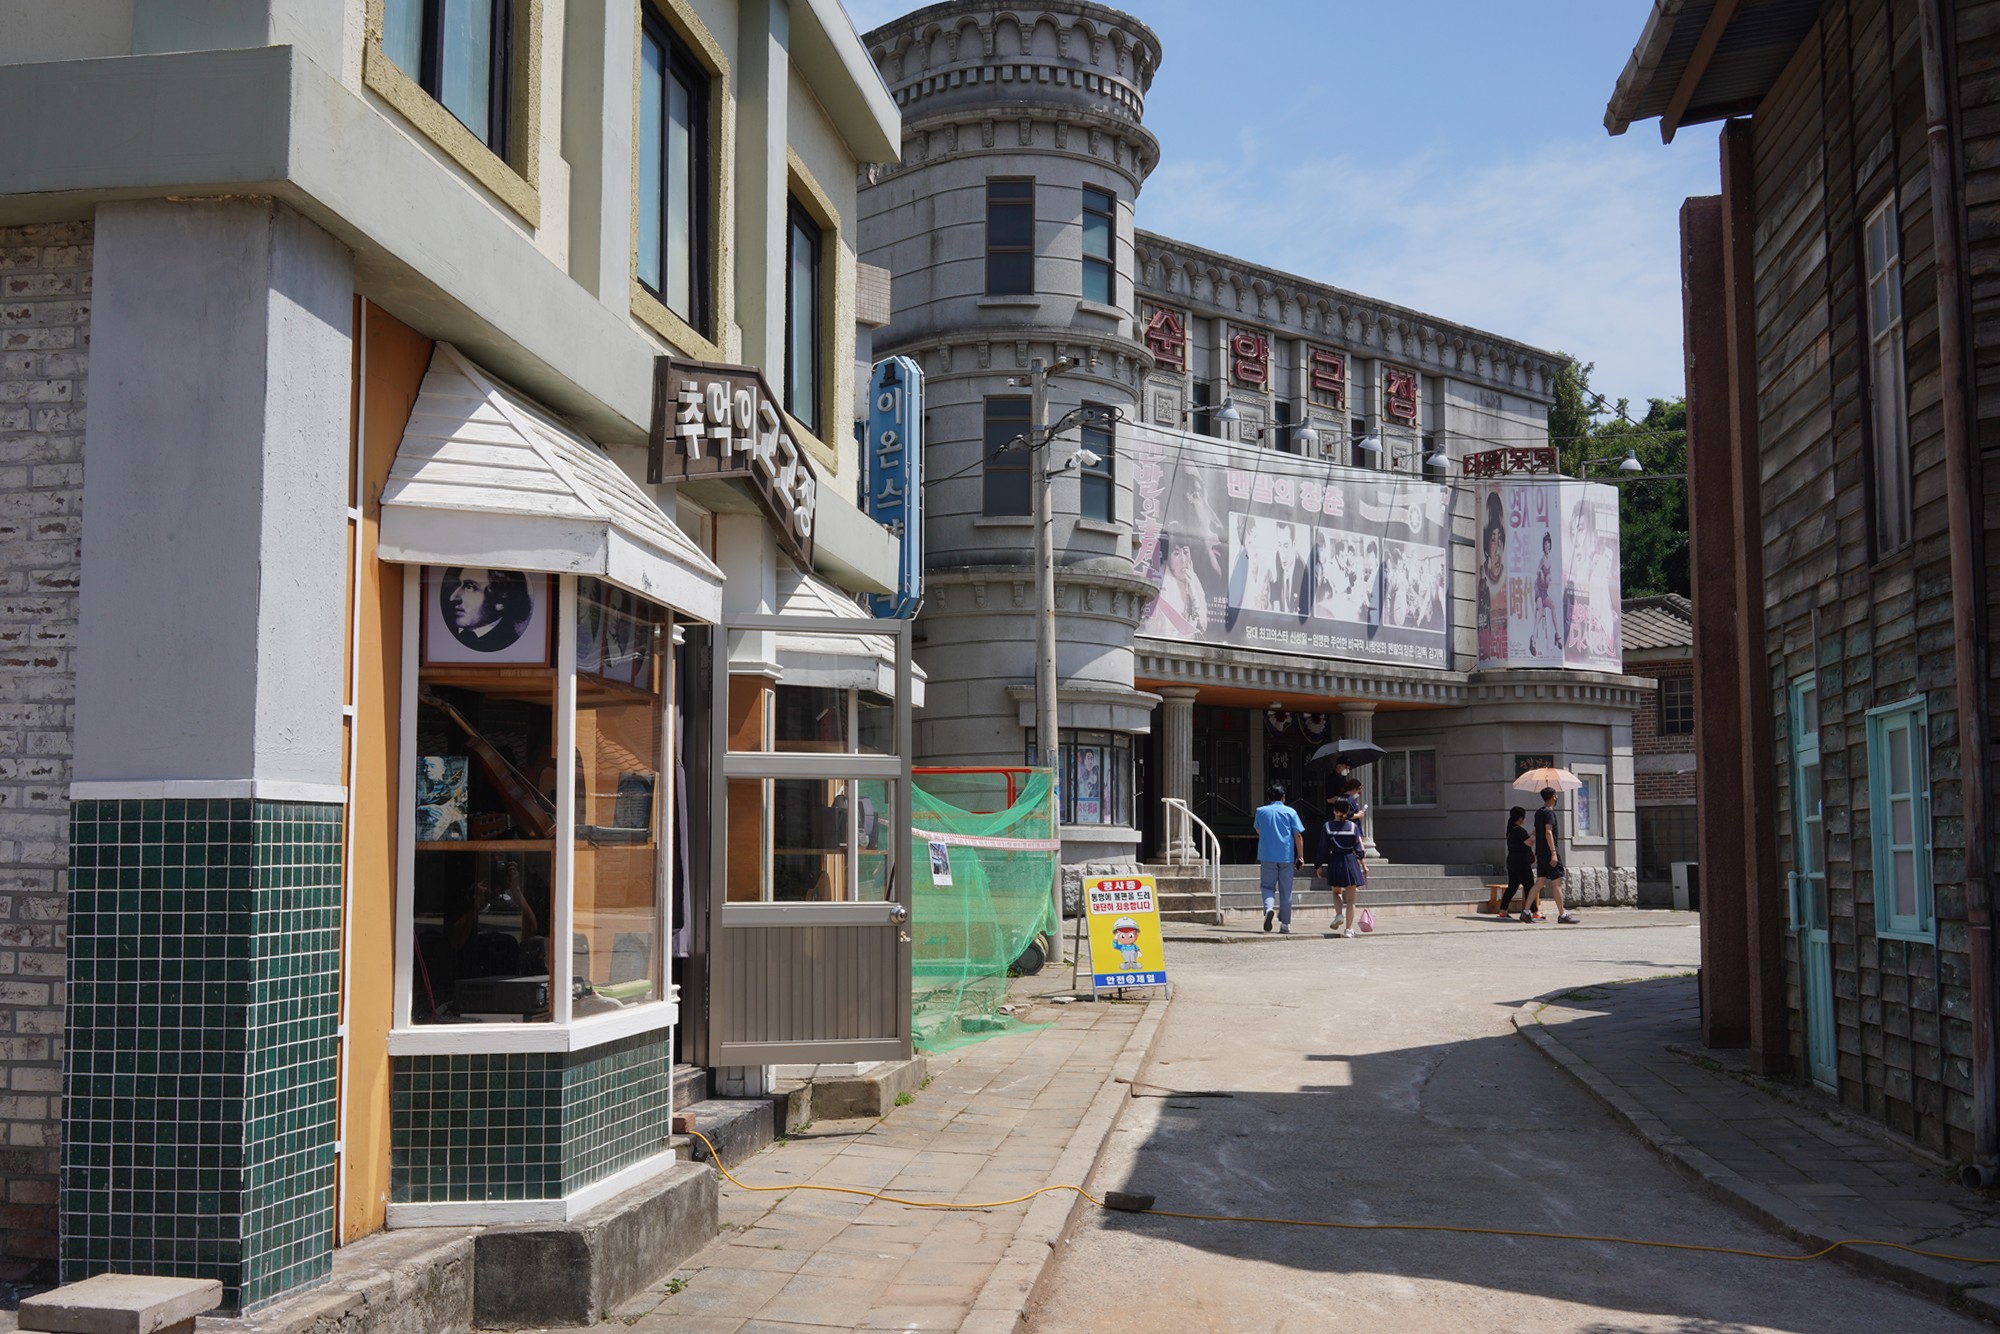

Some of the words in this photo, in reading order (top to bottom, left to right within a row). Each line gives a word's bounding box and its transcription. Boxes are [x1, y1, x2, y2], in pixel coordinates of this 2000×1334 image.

[676, 381, 757, 459] 추억의
[756, 400, 815, 537] 고고장
[1227, 468, 1295, 507] 맨발의
[1299, 480, 1344, 517] 청춘
[1103, 880, 1136, 890] 공사중
[1091, 893, 1112, 902] 통행에
[1114, 892, 1135, 901] 불편을
[1137, 891, 1150, 900] 드려
[1093, 903, 1114, 912] 대단히
[1116, 901, 1151, 911] 죄송합니다
